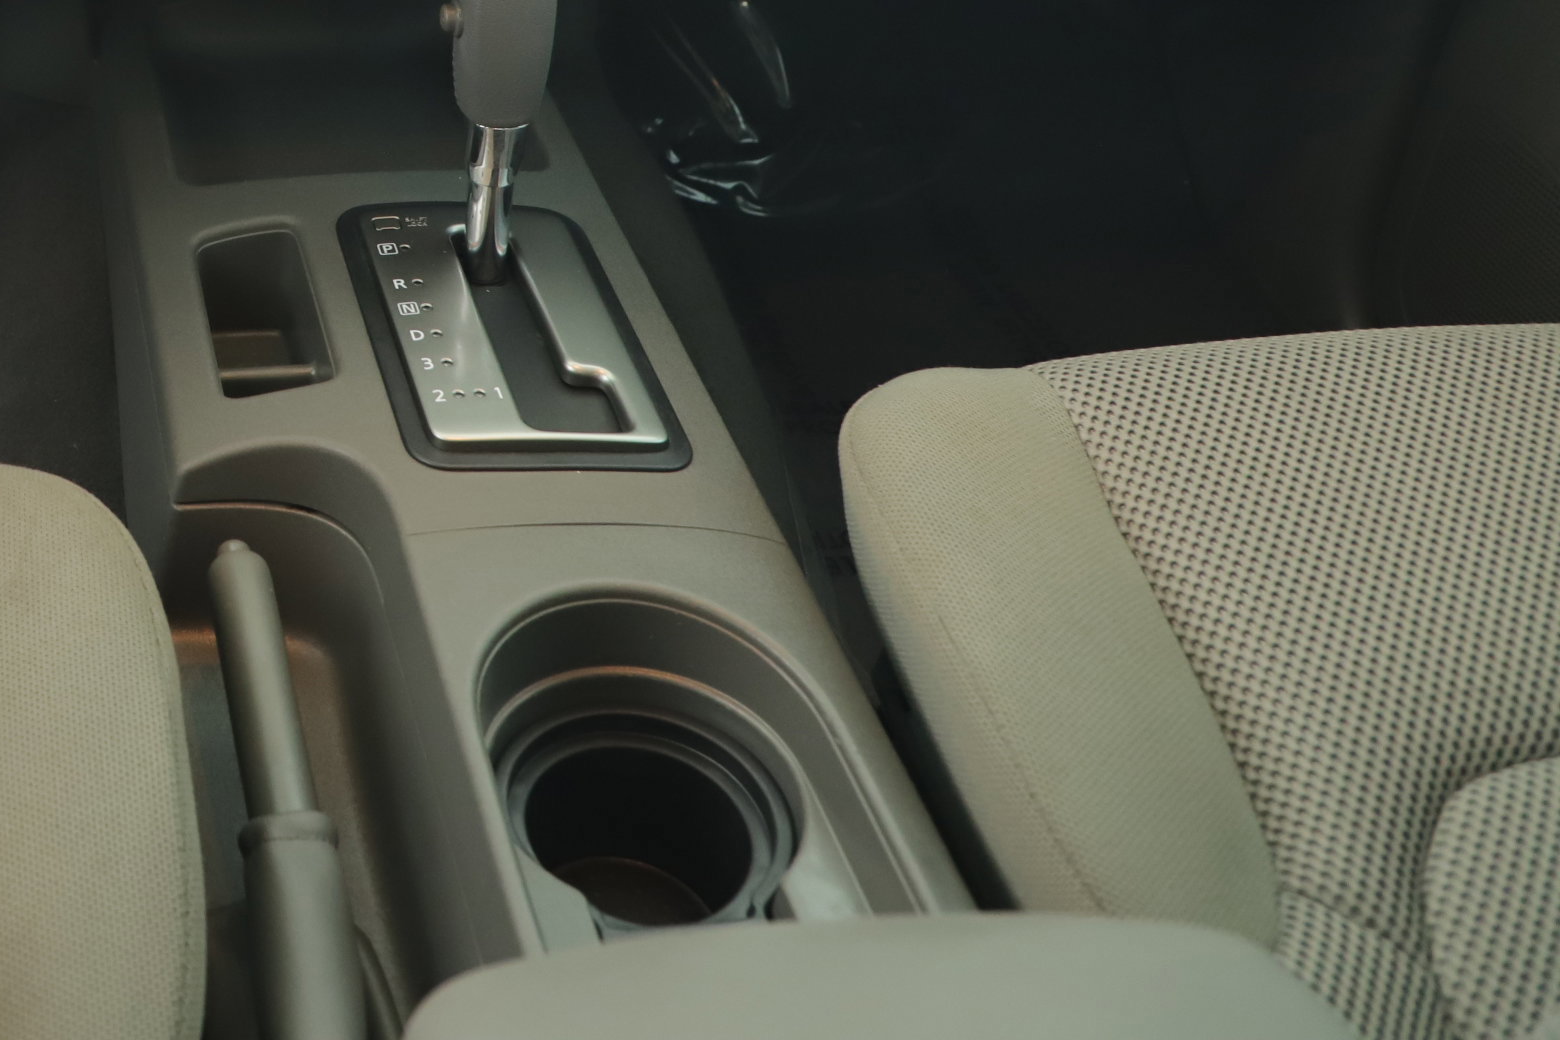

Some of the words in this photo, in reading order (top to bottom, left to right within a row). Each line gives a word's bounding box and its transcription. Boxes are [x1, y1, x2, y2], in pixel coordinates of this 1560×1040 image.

[393, 279, 408, 289] R
[410, 330, 425, 342] D
[421, 358, 434, 370] 3
[432, 389, 447, 402] 2
[494, 387, 504, 400] 1
